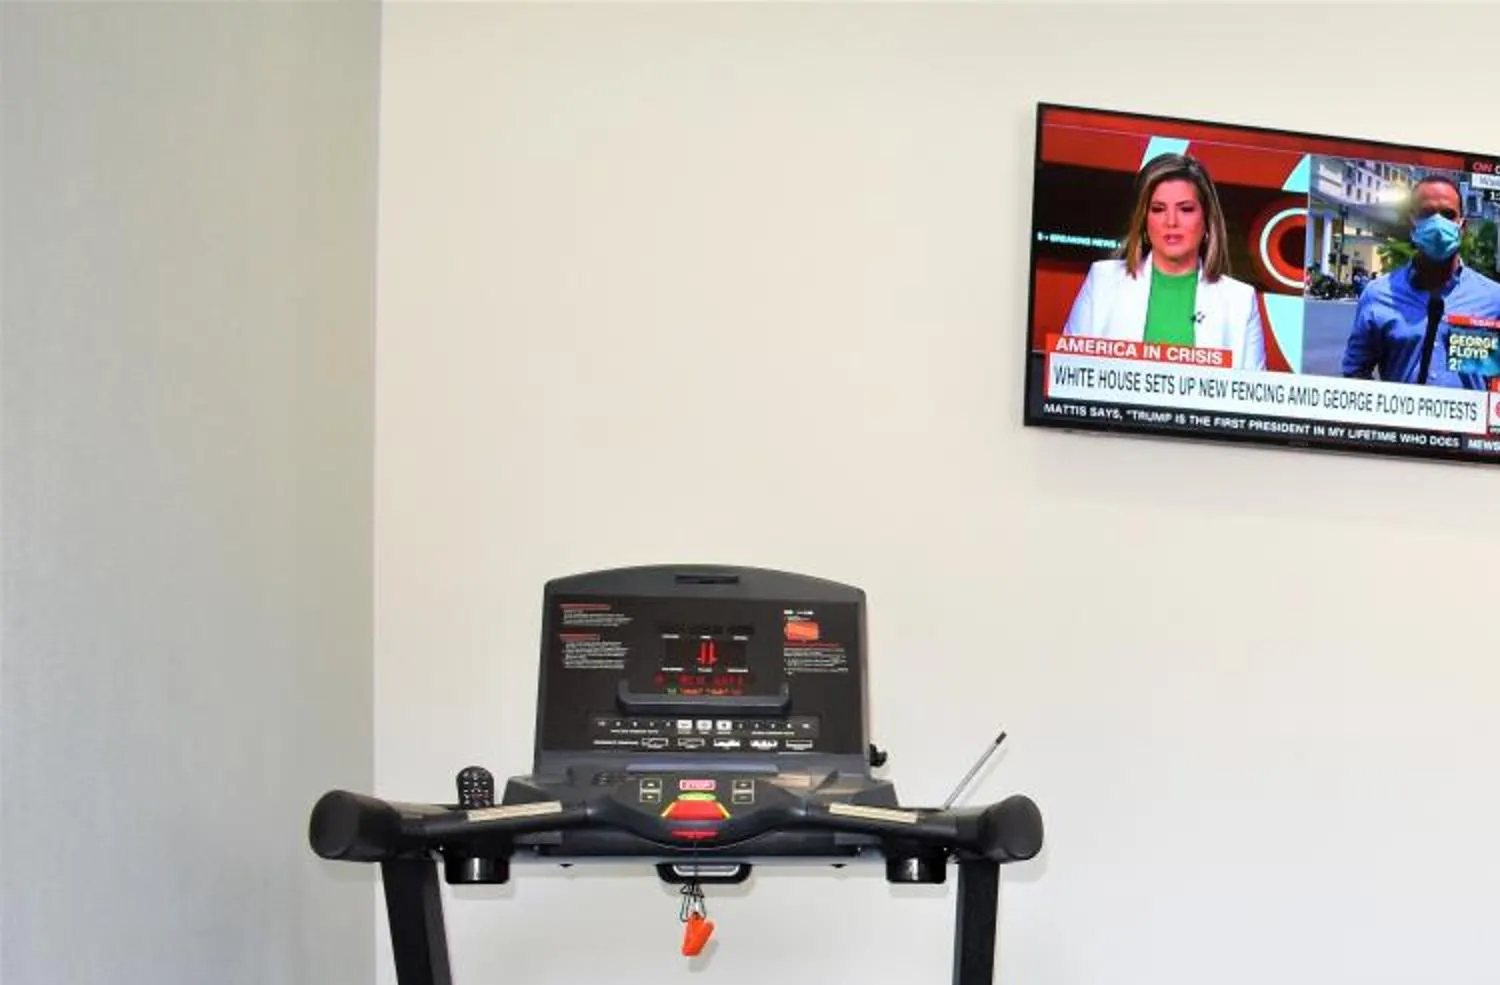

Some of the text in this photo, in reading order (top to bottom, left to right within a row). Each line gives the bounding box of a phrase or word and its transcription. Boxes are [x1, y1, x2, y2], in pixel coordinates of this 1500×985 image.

[1056, 336, 1223, 365] AMERICA IN CRISIS
[1449, 333, 1499, 350] GEORGE
[1449, 345, 1489, 360] FLOYD
[1054, 364, 1478, 421] WHITE HOUSE SETS UP NEW FENCING AMID GEORGE FLOYD PROTESTS
[1043, 403, 1087, 417] MATTIS
[1089, 406, 1123, 421] SAYS,
[1175, 413, 1186, 425] IS
[1189, 415, 1211, 427] THE
[1214, 417, 1246, 429] FIRST
[1249, 419, 1311, 435] PRESIDENT
[1313, 425, 1325, 437] IN
[1328, 426, 1345, 438] MY
[1348, 429, 1397, 443] LIFETIME
[1400, 433, 1427, 445] WHO
[1430, 435, 1460, 448] DOES
